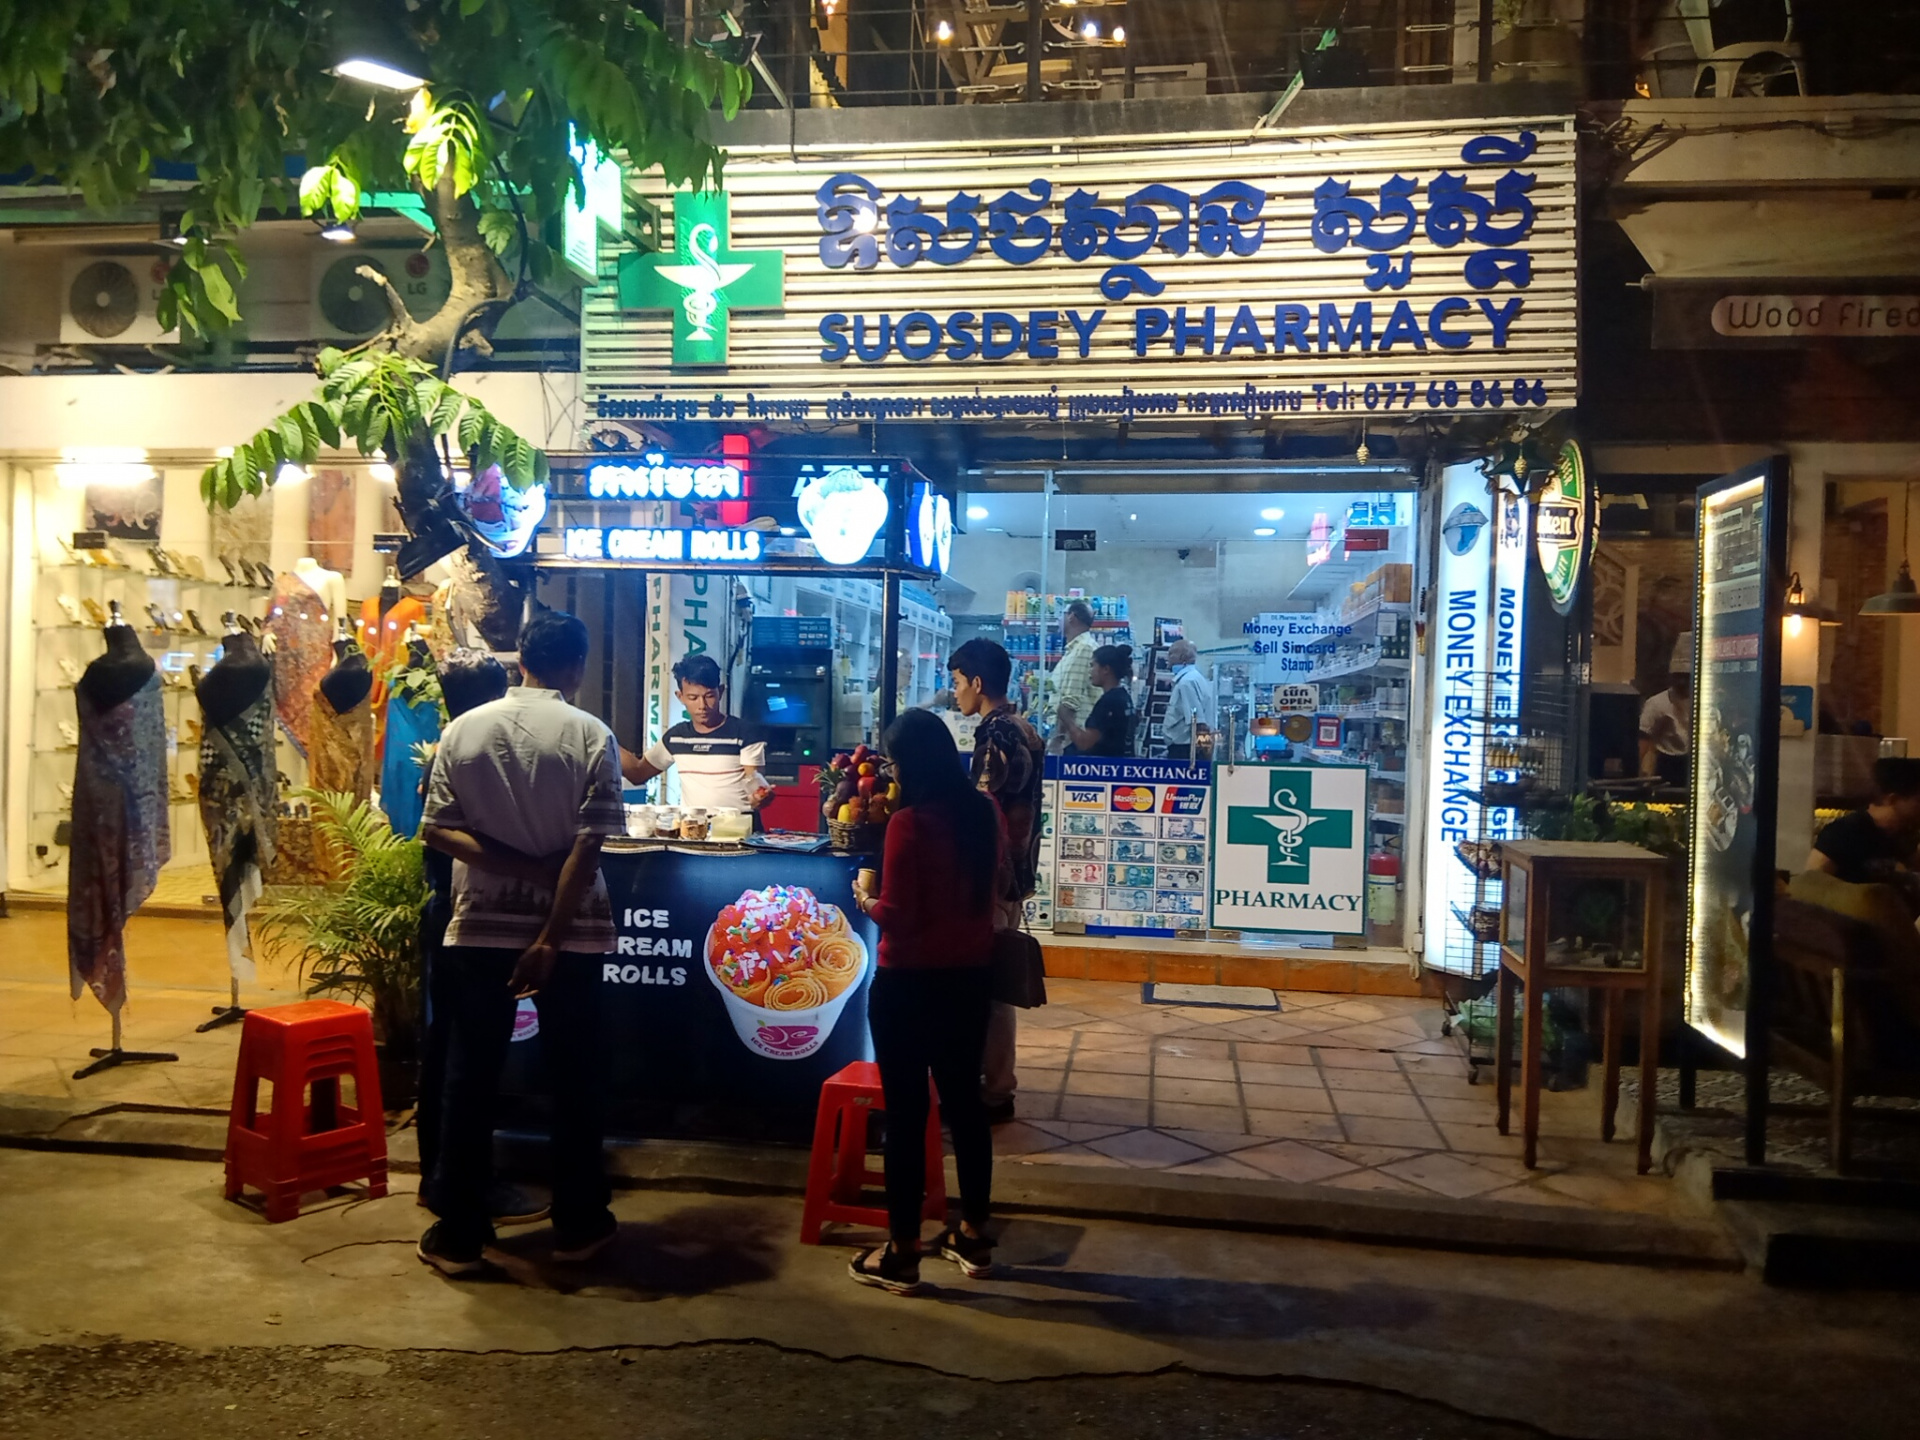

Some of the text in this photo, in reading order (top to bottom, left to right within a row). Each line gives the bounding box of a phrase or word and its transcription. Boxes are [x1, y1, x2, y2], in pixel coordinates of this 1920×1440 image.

[152, 288, 161, 300] L
[407, 281, 427, 295] LG
[1727, 301, 1824, 329] Wood
[819, 296, 1525, 362] SUOSDEY PHARMACY
[1312, 381, 1354, 410] Tel:
[1364, 381, 1416, 409] 077
[1426, 379, 1459, 408] 68
[1470, 379, 1504, 408] 86
[1513, 378, 1548, 406] 86
[790, 464, 890, 498] AM
[1242, 622, 1352, 637] Money Exchange
[1496, 587, 1516, 687] MONEY
[1254, 640, 1336, 654] Sell Simcard
[1281, 658, 1314, 673] Stamp
[1279, 697, 1313, 705] OPEN
[1441, 590, 1476, 842] MONEY EXCHANGE
[1063, 763, 1208, 780] MONEY EXCHANGE
[1071, 792, 1098, 803] VISA
[1165, 793, 1203, 803] UnionPay
[1214, 889, 1362, 912] PHARMACY
[624, 908, 670, 929] ICE
[603, 936, 693, 958] REAM
[602, 963, 687, 986] ROLLS
[764, 1047, 793, 1057] CREAM
[794, 1041, 819, 1056] ROLLS
